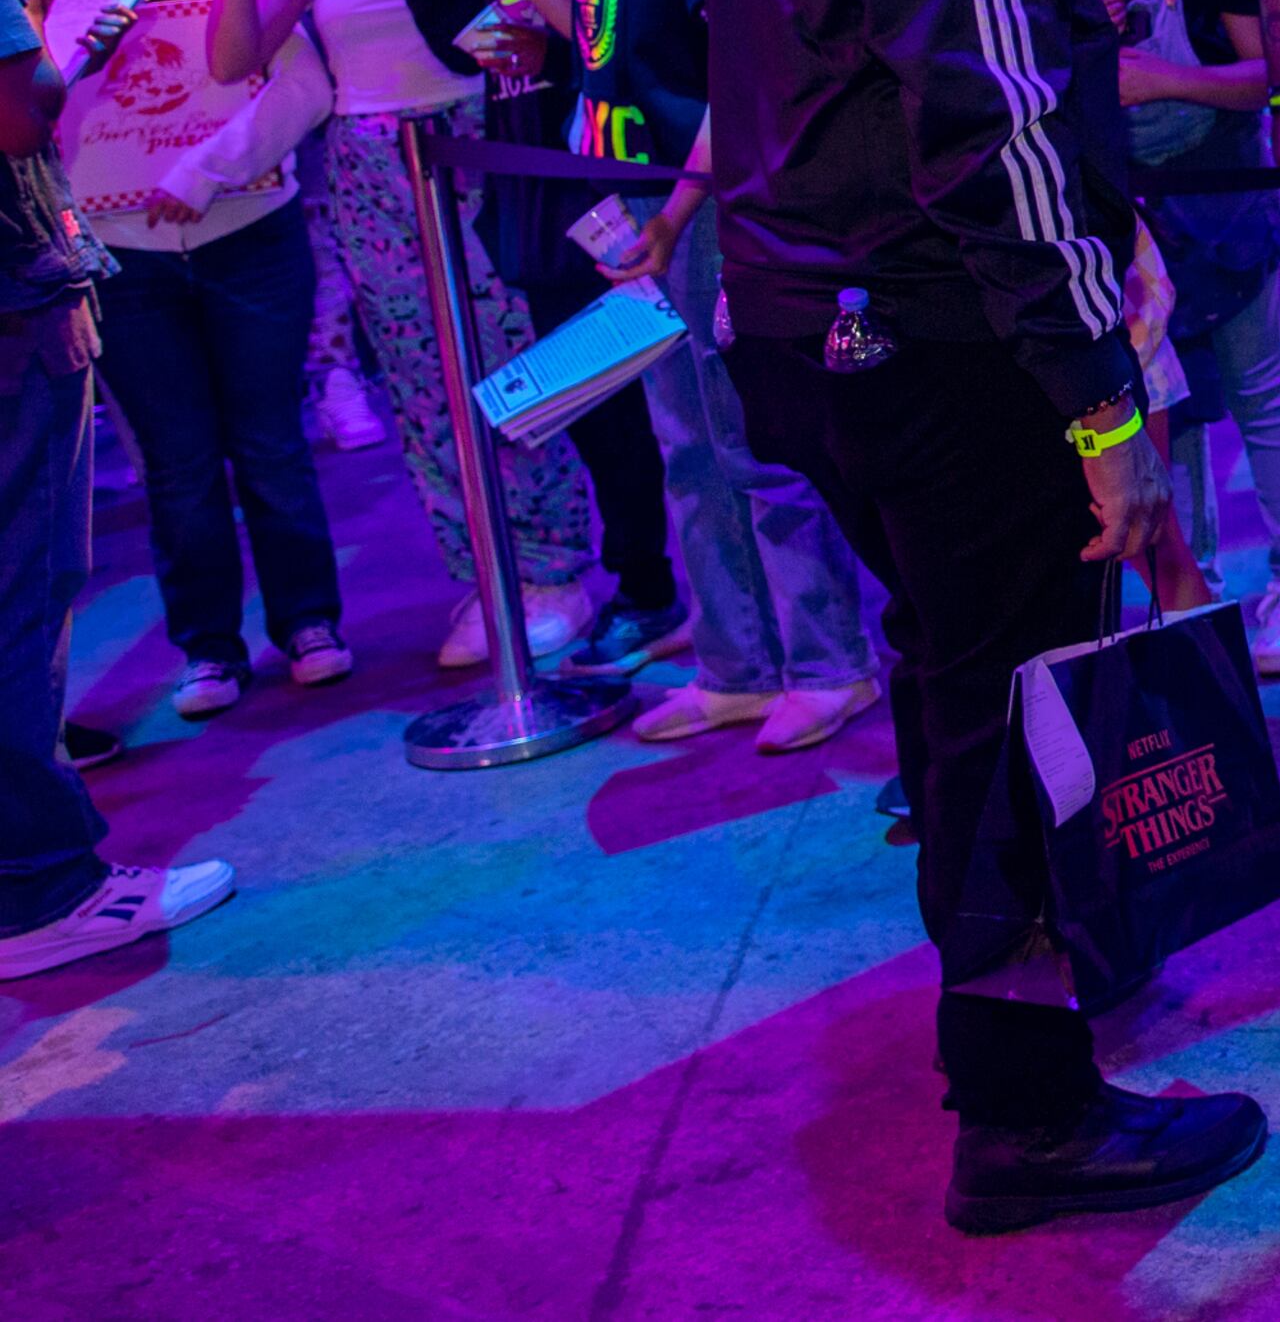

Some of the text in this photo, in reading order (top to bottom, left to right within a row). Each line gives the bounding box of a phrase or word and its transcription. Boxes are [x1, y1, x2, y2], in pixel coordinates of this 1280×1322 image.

[1126, 728, 1172, 761] NETFLIX
[1101, 752, 1226, 840] STRANGER
[1120, 794, 1216, 860] THINGS
